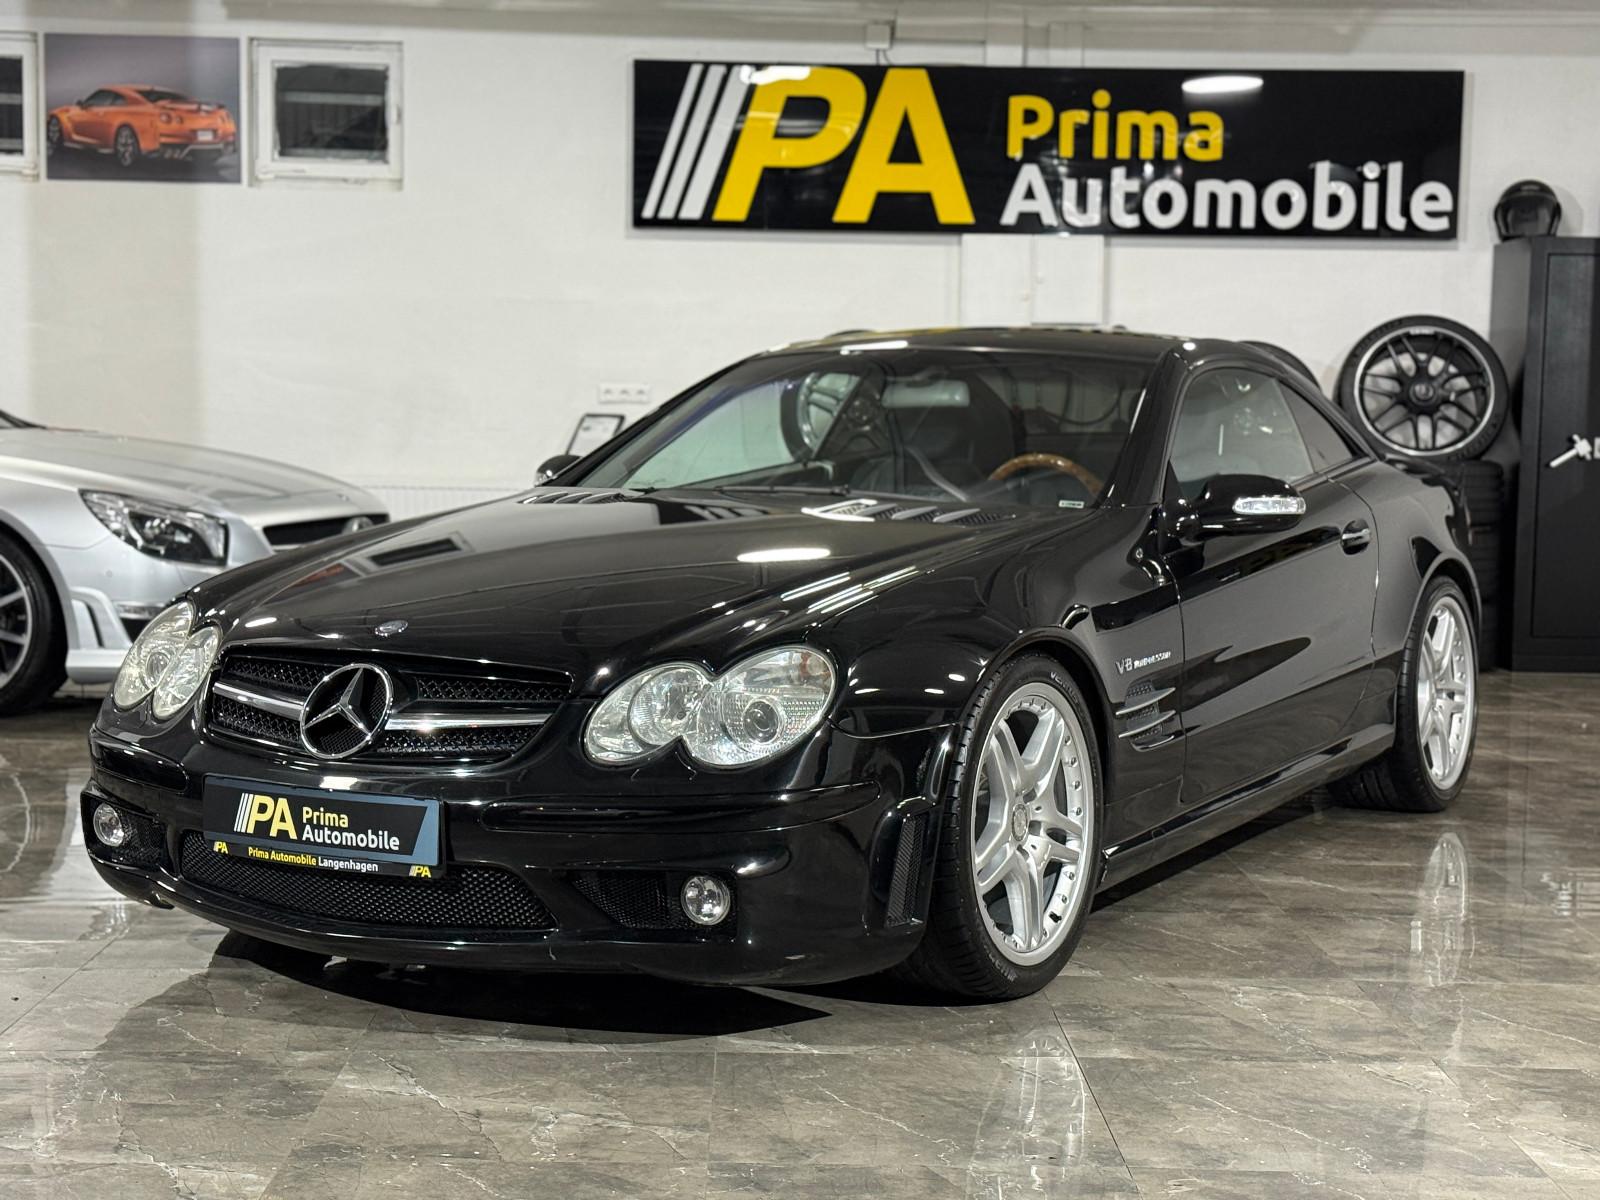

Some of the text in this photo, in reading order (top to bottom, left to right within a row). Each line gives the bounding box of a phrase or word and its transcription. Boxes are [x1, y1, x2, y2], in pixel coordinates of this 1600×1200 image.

[1007, 89, 1224, 162] Prima
[712, 66, 976, 225] PA
[1001, 160, 1454, 232] Automobile
[1115, 657, 1132, 674] V8
[247, 795, 298, 840] PA
[302, 807, 349, 828] Prima
[215, 841, 228, 854] PA
[301, 825, 400, 850] Automobile
[248, 847, 379, 873] Prima Automobile Langenhagen
[412, 866, 432, 878] PA
